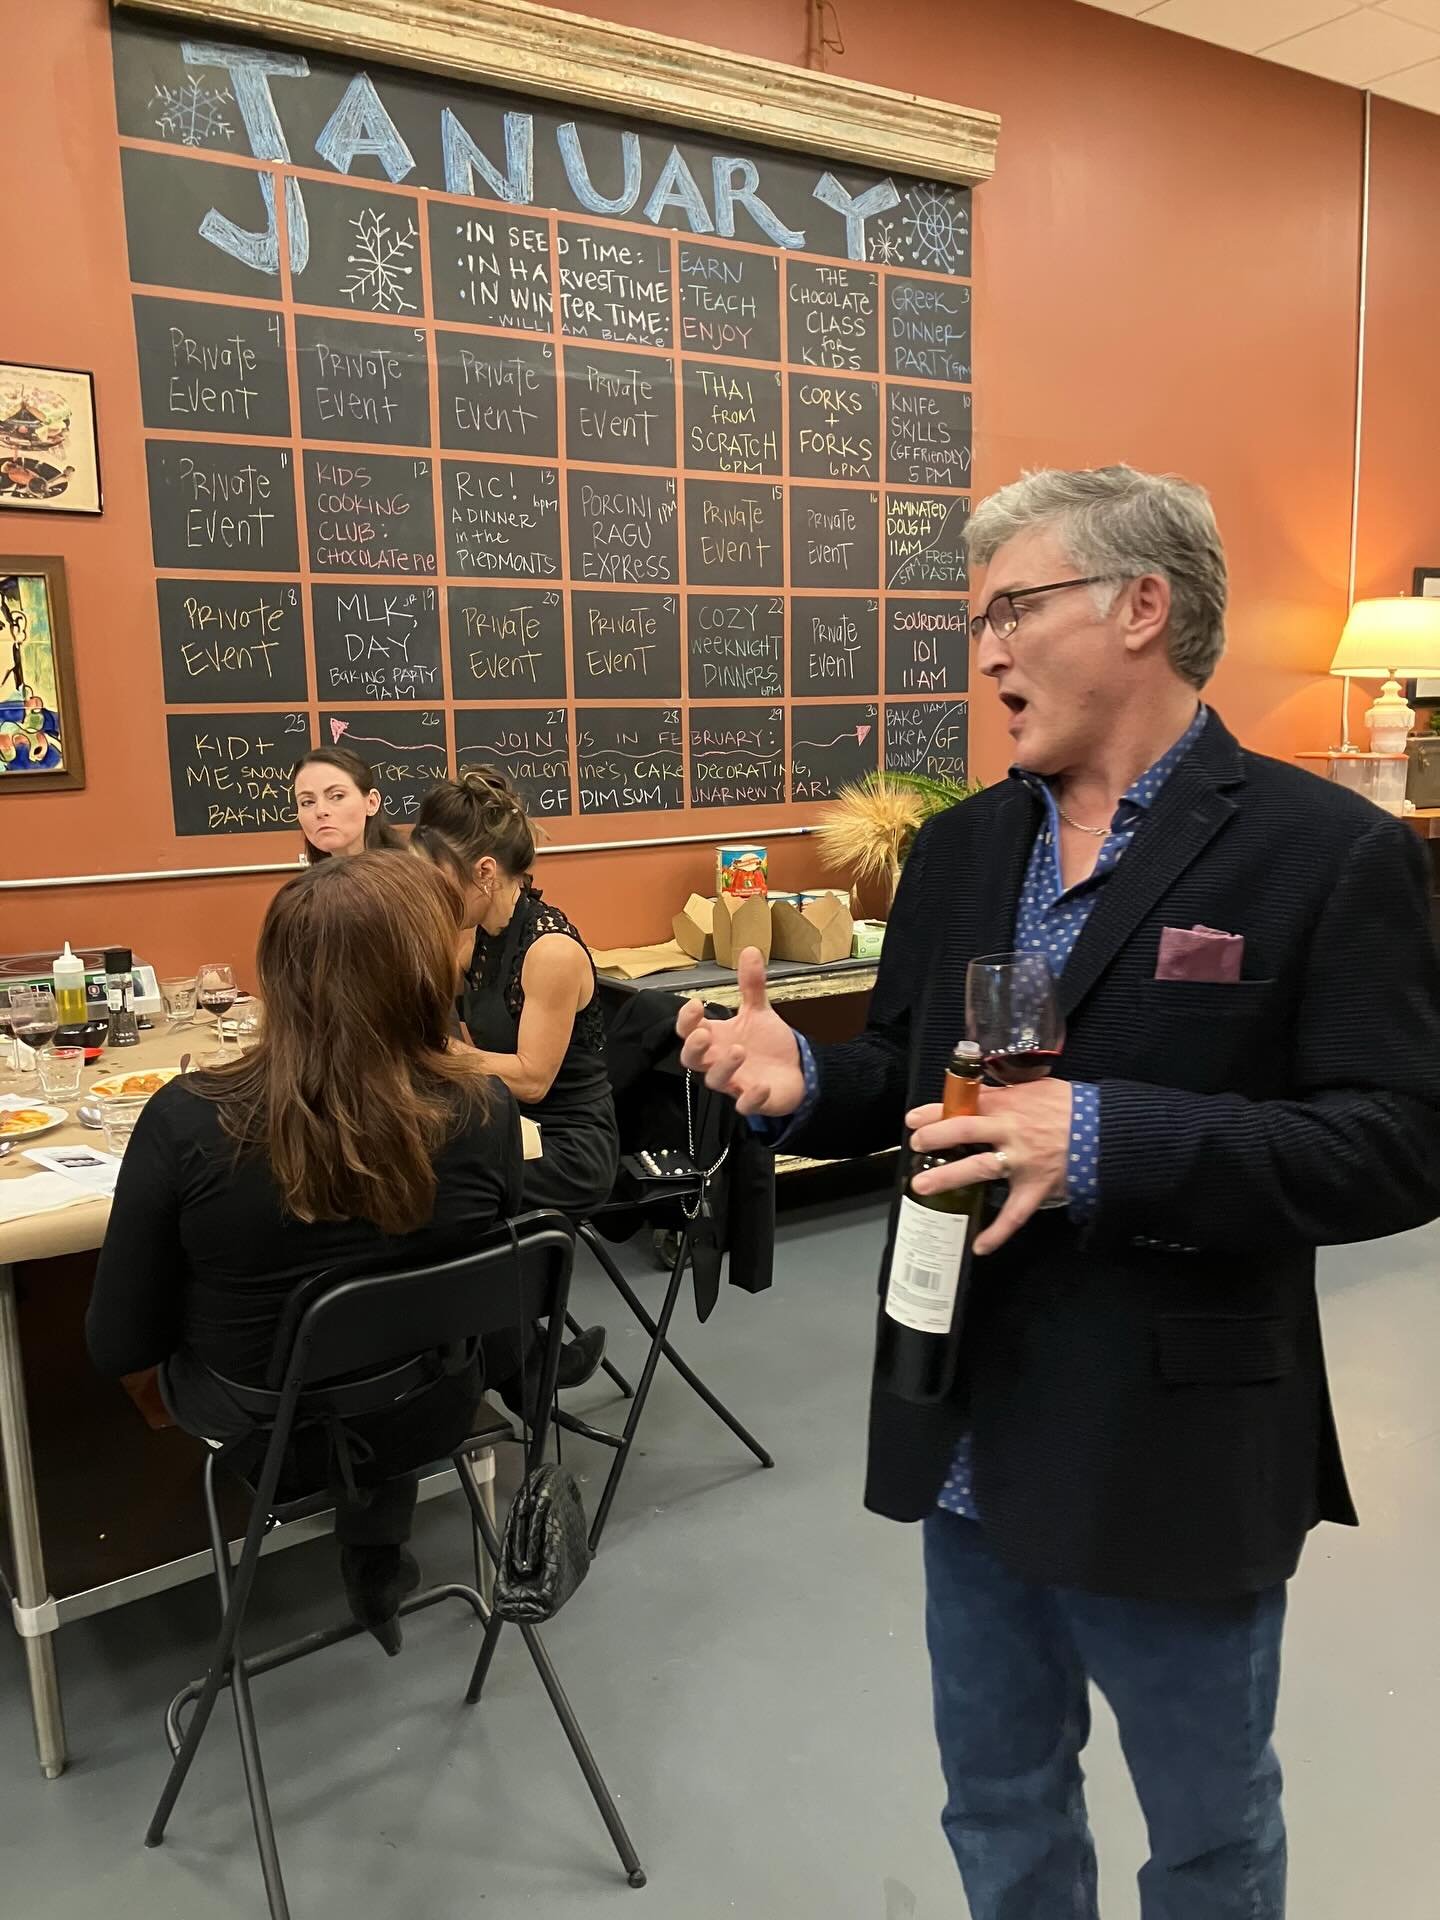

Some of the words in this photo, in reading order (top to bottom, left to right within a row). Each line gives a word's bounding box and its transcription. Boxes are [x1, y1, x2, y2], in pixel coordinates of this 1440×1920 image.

[180, 41, 901, 275] JANUARY
[509, 227, 569, 254] SEED
[658, 245, 742, 284] LEARN
[816, 268, 848, 287] THE
[869, 274, 878, 285] 2
[961, 288, 970, 303] 3
[268, 314, 281, 348] 4
[604, 304, 669, 334] TIME:
[683, 317, 752, 350] ENJOY
[806, 310, 866, 337] CLASS
[414, 328, 426, 342] 5
[542, 343, 552, 358] 6
[802, 349, 862, 371] KIDS
[665, 358, 673, 374] 7
[895, 346, 953, 377] PARTY
[696, 370, 753, 404] THAI
[774, 371, 782, 387] 8
[871, 382, 878, 396] 9
[800, 384, 862, 415] CORKS
[891, 416, 951, 444] SKILLS
[691, 426, 777, 461] SCRATCH
[800, 429, 872, 461] FORKS
[316, 461, 372, 488] KIDS
[413, 461, 429, 479] 12
[719, 457, 763, 474] 6PM
[829, 462, 871, 479] 6PM
[455, 471, 517, 501] RIC!
[540, 470, 555, 485] 13
[665, 477, 675, 495] 14
[581, 484, 652, 520] PORCINI
[772, 486, 783, 501] 15
[869, 492, 878, 504] 16
[317, 493, 410, 516] COOKING
[452, 507, 462, 524] A
[592, 521, 651, 549] RAGU
[887, 518, 931, 536] DOUGH
[890, 540, 922, 556] 11AM
[920, 564, 966, 582] PASTA
[279, 588, 298, 606] 18
[422, 587, 435, 611] 19
[542, 591, 560, 607] 20
[662, 596, 676, 615] 21
[768, 598, 784, 615] 22
[698, 604, 759, 632] COZY
[893, 610, 967, 635] SOURDOUGH
[345, 633, 411, 663] DAY
[913, 637, 937, 665] 101
[392, 665, 438, 684] PARTY
[903, 666, 946, 691] 11AM
[365, 683, 416, 701] 9AM
[760, 685, 783, 697] 6PM
[768, 709, 783, 721] 29
[865, 704, 877, 718] 30
[923, 701, 947, 713] 11AM
[958, 704, 967, 715] 31
[284, 713, 306, 733] 25
[421, 712, 440, 727] 26
[547, 709, 565, 725] 27
[663, 710, 680, 724] 28
[194, 733, 249, 761] KID
[495, 731, 552, 749] JOIN
[565, 730, 594, 746] US
[616, 732, 638, 745] IN
[935, 726, 960, 750] GF
[885, 748, 923, 770] NONNA
[241, 763, 295, 781] SNOW
[247, 782, 294, 803] DAY
[540, 788, 569, 810] GF
[580, 789, 619, 811] DIM
[622, 785, 668, 809] SUM,
[676, 785, 734, 804] LUNAR
[208, 804, 298, 829] BAKING
